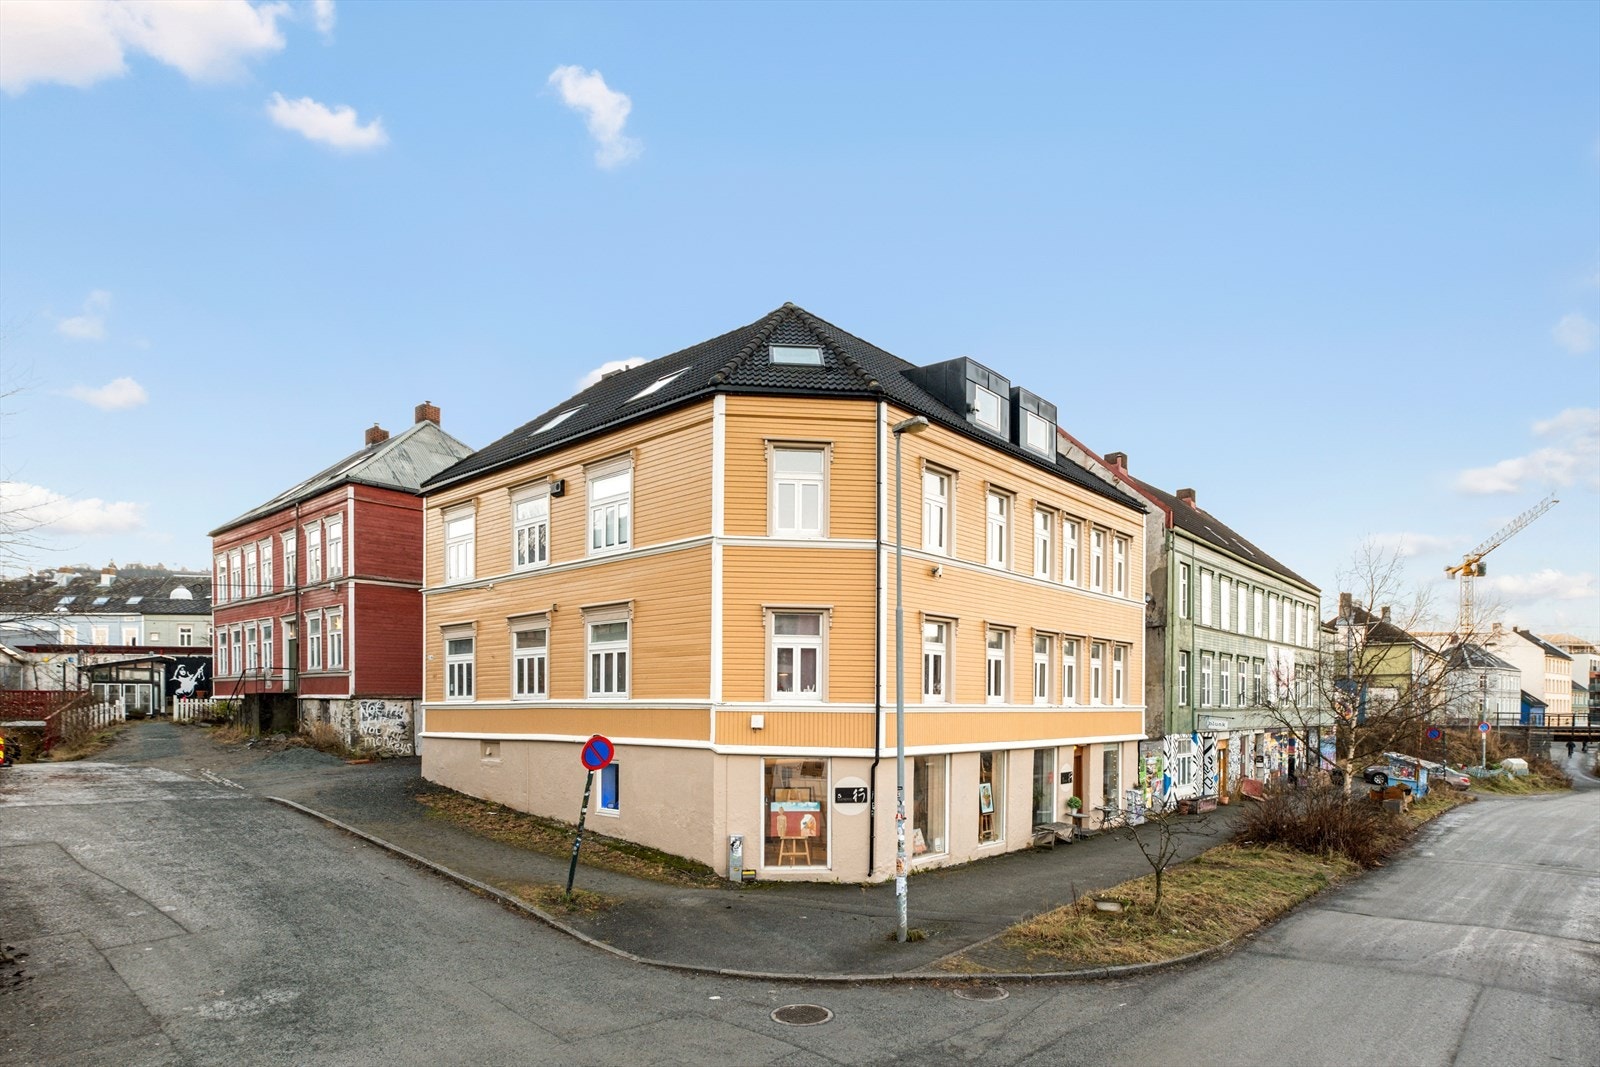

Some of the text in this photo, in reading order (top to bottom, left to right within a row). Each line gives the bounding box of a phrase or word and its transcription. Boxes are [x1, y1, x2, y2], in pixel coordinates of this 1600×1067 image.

[359, 700, 383, 717] Not
[359, 724, 382, 736] Not
[364, 736, 412, 755] monkeys
